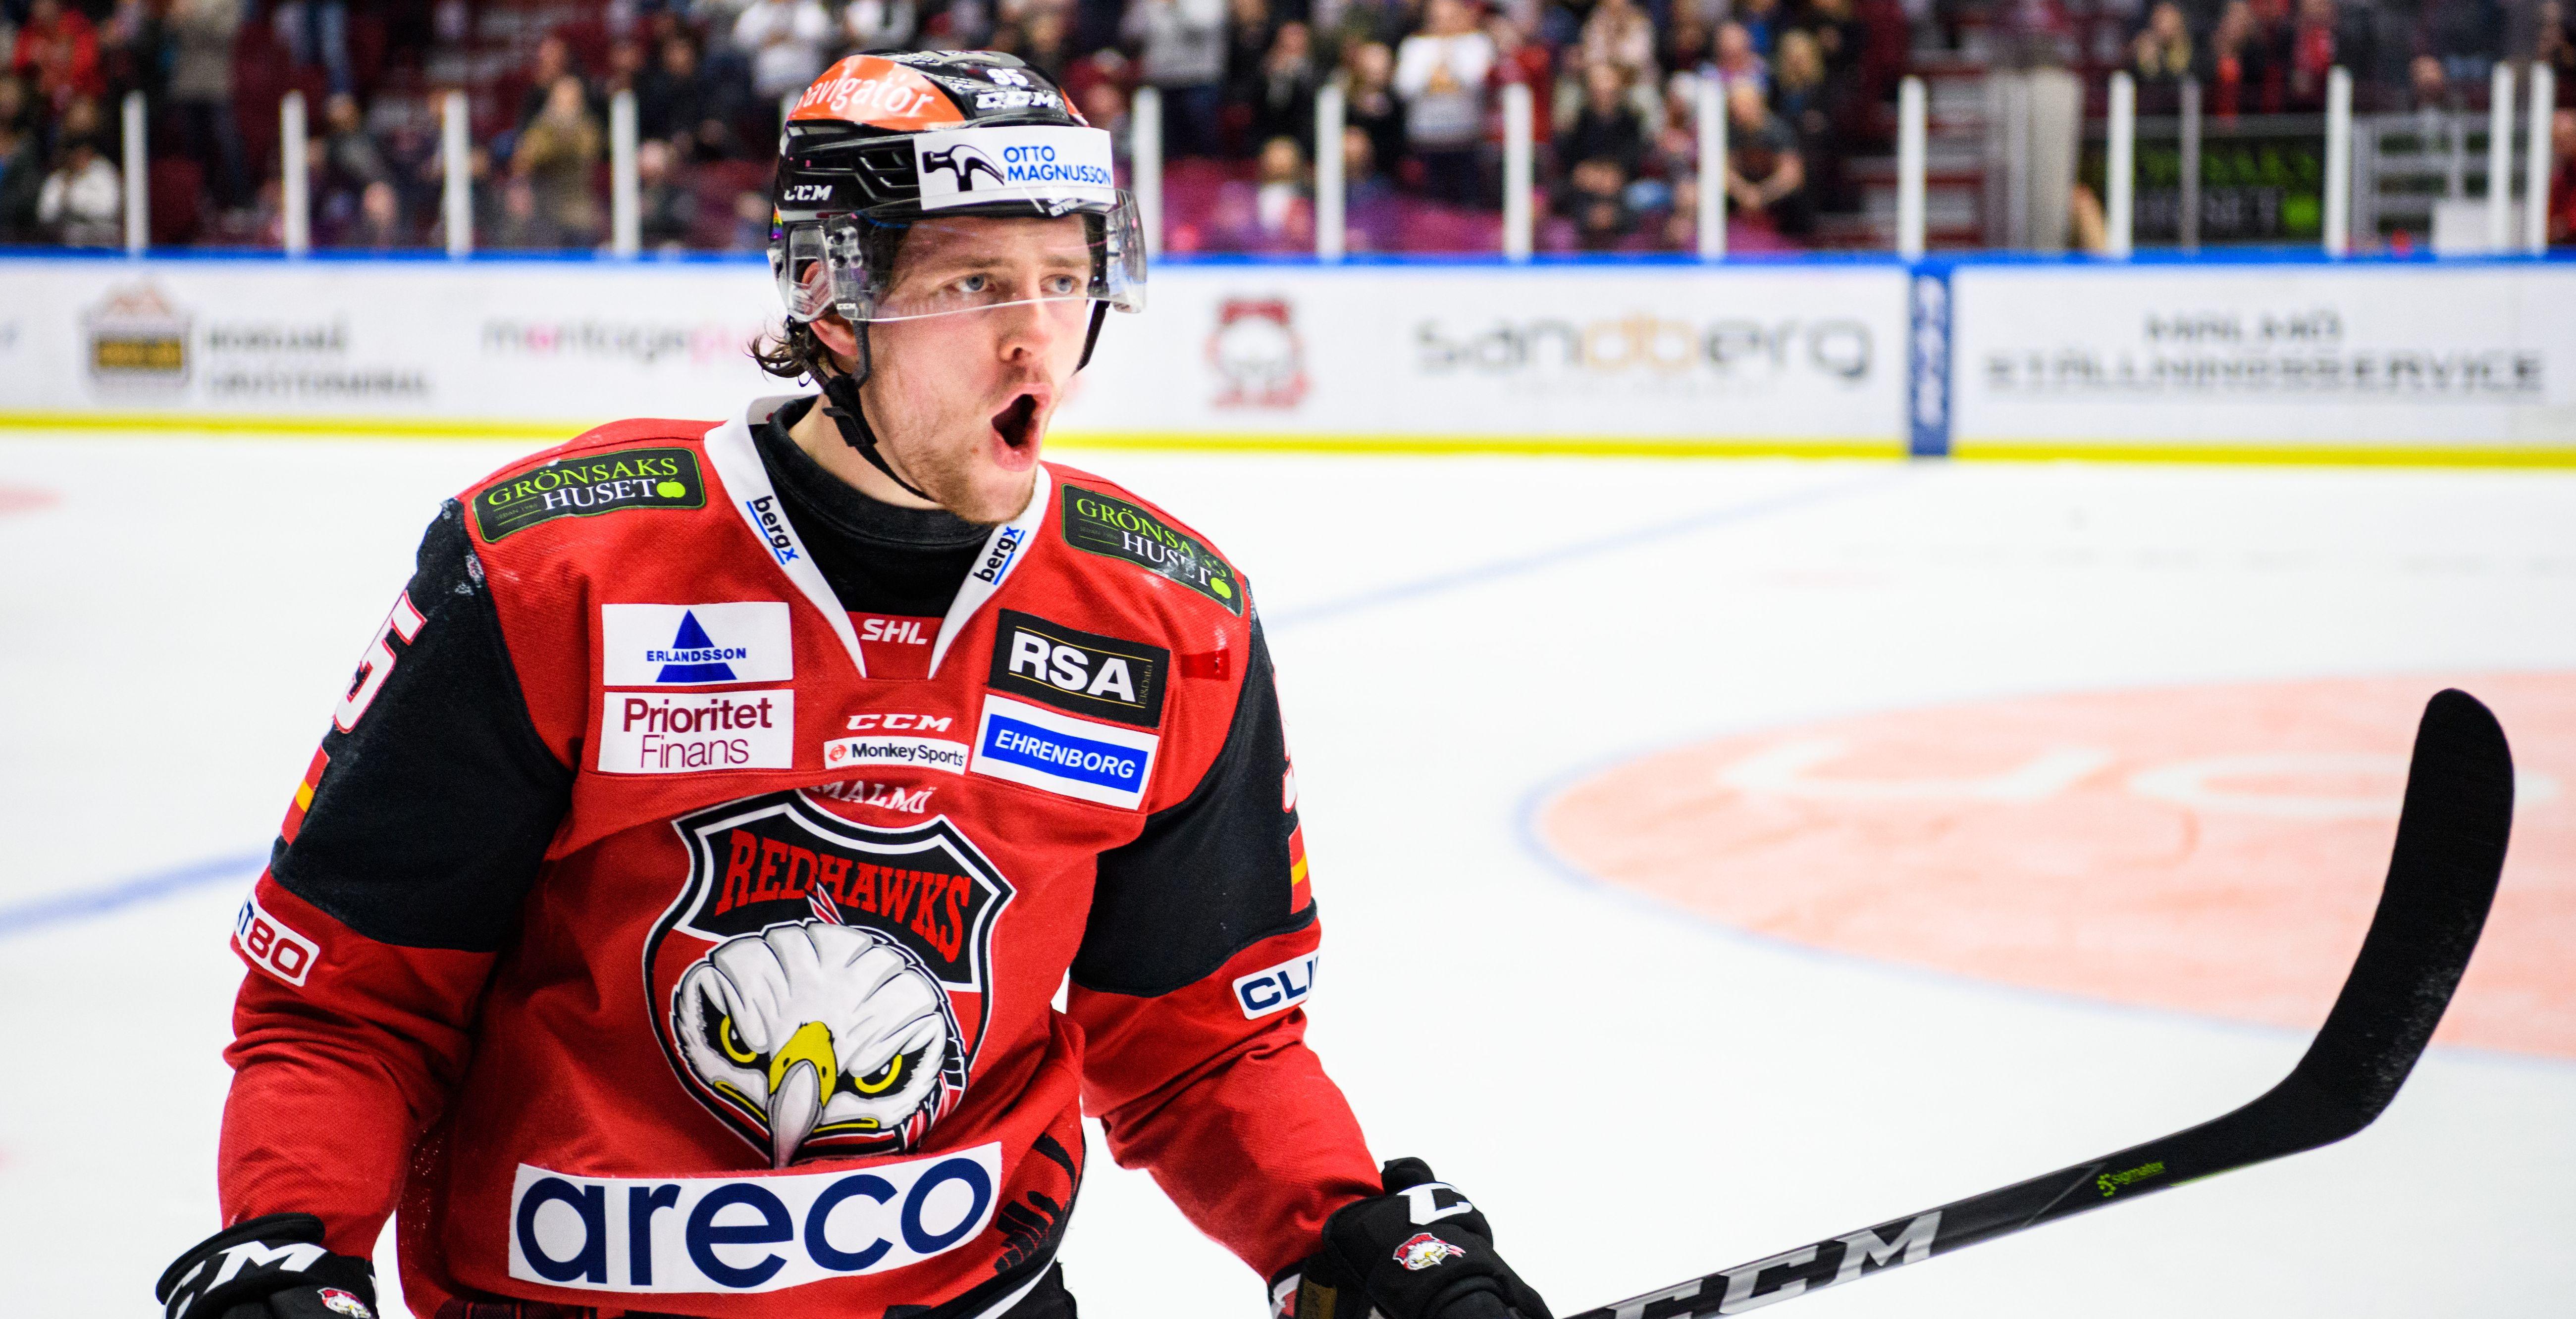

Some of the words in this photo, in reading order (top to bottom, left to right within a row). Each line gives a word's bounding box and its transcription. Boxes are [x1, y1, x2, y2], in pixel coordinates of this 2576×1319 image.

[986, 68, 1029, 87] 95
[976, 91, 1057, 109] CCM
[1003, 146, 1055, 163] OTTO
[1007, 164, 1111, 185] MAGNUSSON
[784, 185, 833, 201] CCM
[488, 457, 679, 506] GRÖNSAKS
[544, 478, 656, 511] HUSET
[752, 496, 799, 561] bergx
[973, 525, 1019, 582] bergx
[861, 618, 928, 645] SHL
[646, 648, 746, 662] ERLANDSSON
[1008, 631, 1136, 702] RSA
[623, 697, 773, 733] Prioritet
[846, 713, 952, 732] CCM
[641, 734, 749, 768] Finans
[852, 743, 963, 766] MonkeySports
[995, 729, 1136, 779] EHRENBORG
[714, 828, 971, 963] REDHAWKS
[516, 1157, 992, 1288] areco
